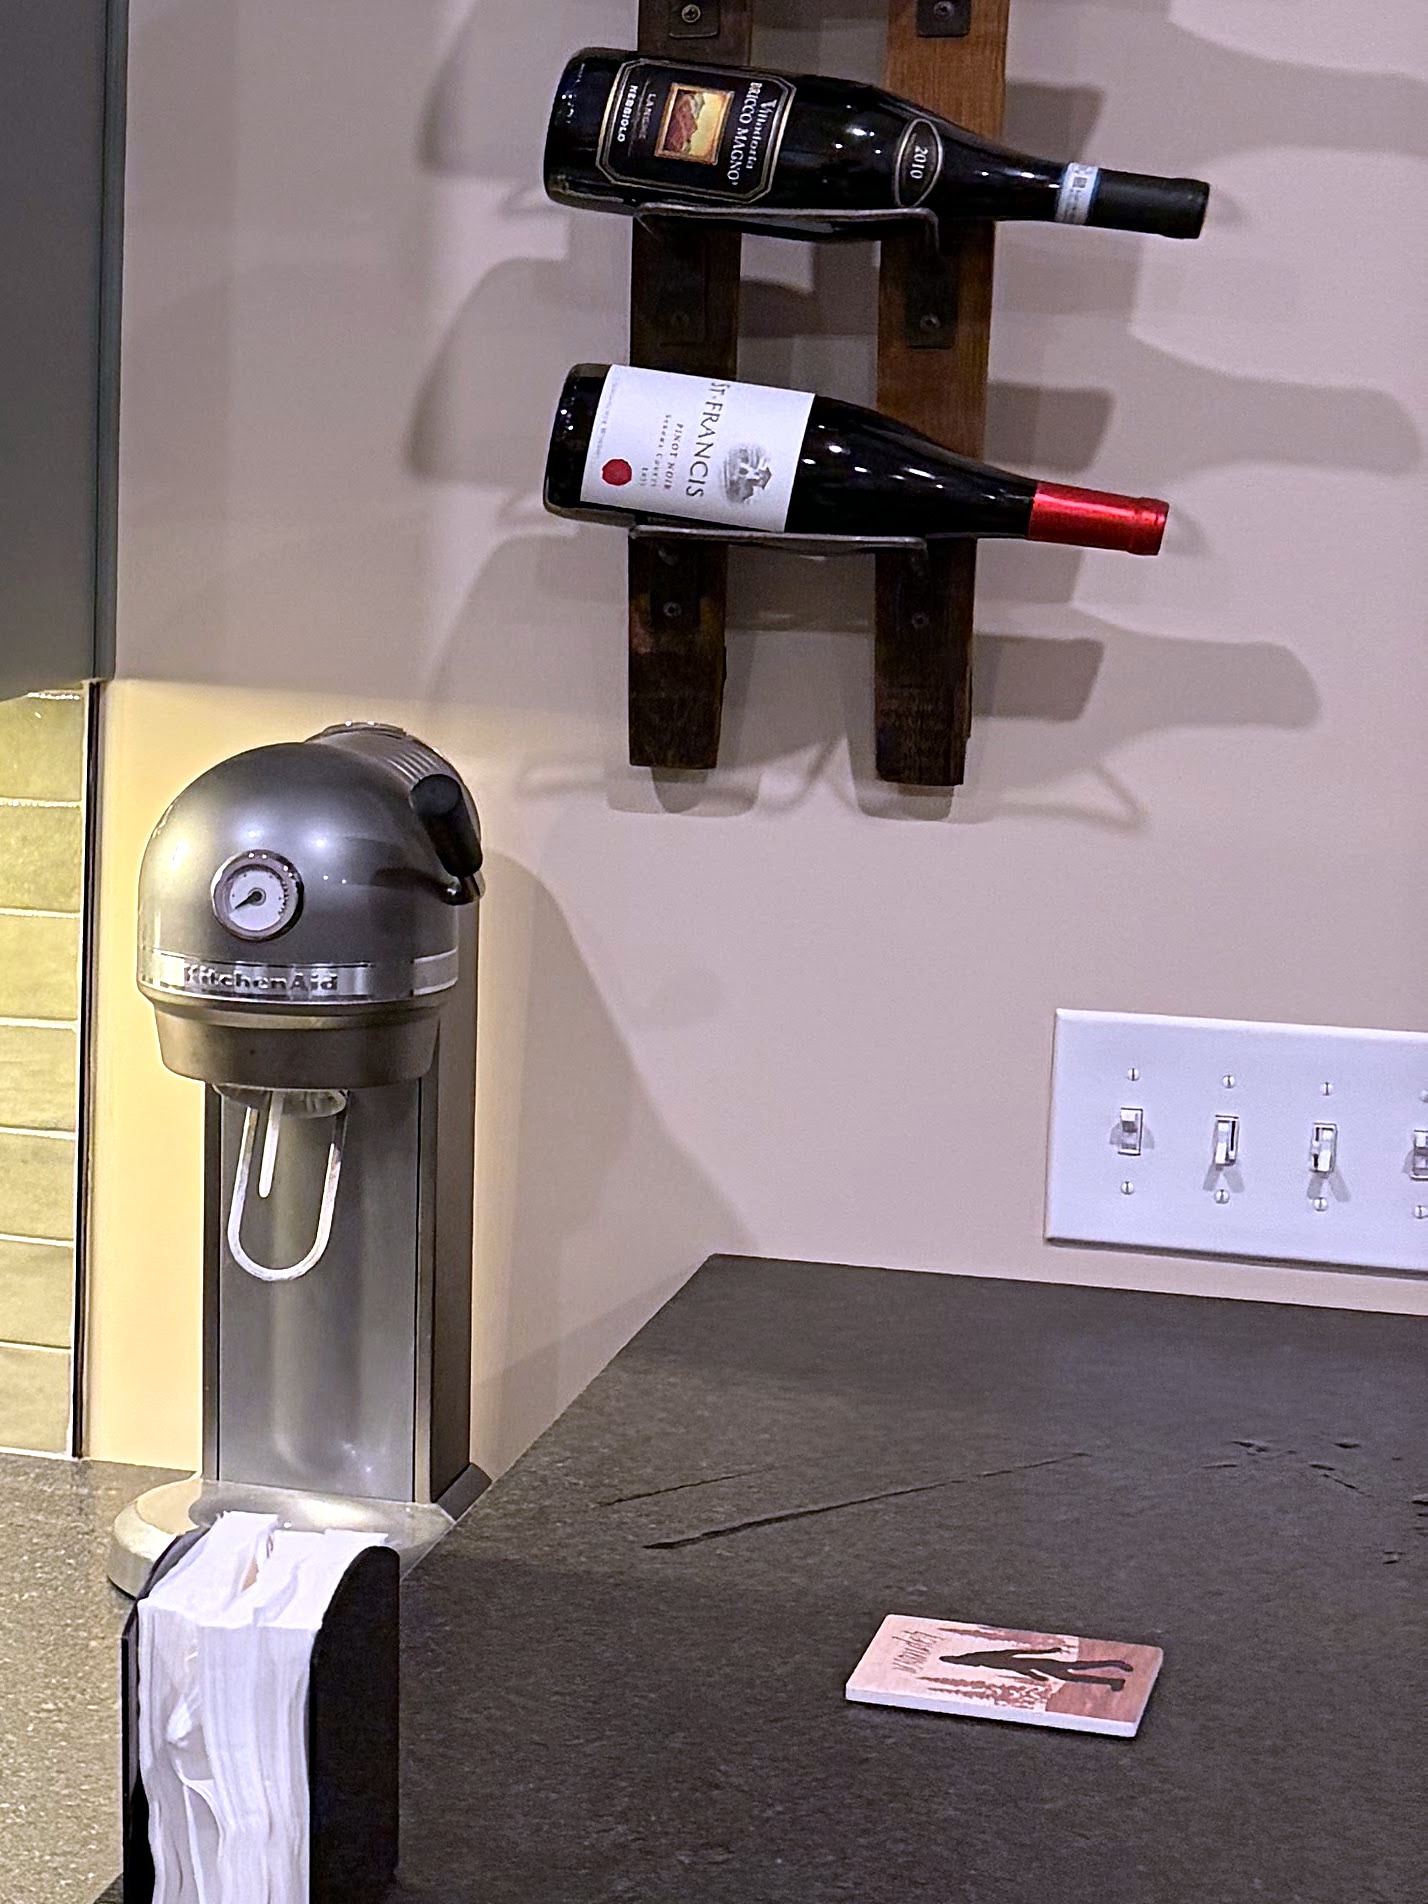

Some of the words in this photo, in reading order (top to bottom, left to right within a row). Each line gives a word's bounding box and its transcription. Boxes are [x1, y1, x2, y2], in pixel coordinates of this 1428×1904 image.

[739, 81, 764, 125] BRICCO
[909, 145, 929, 180] 2010
[184, 962, 338, 991] KitchenAid
